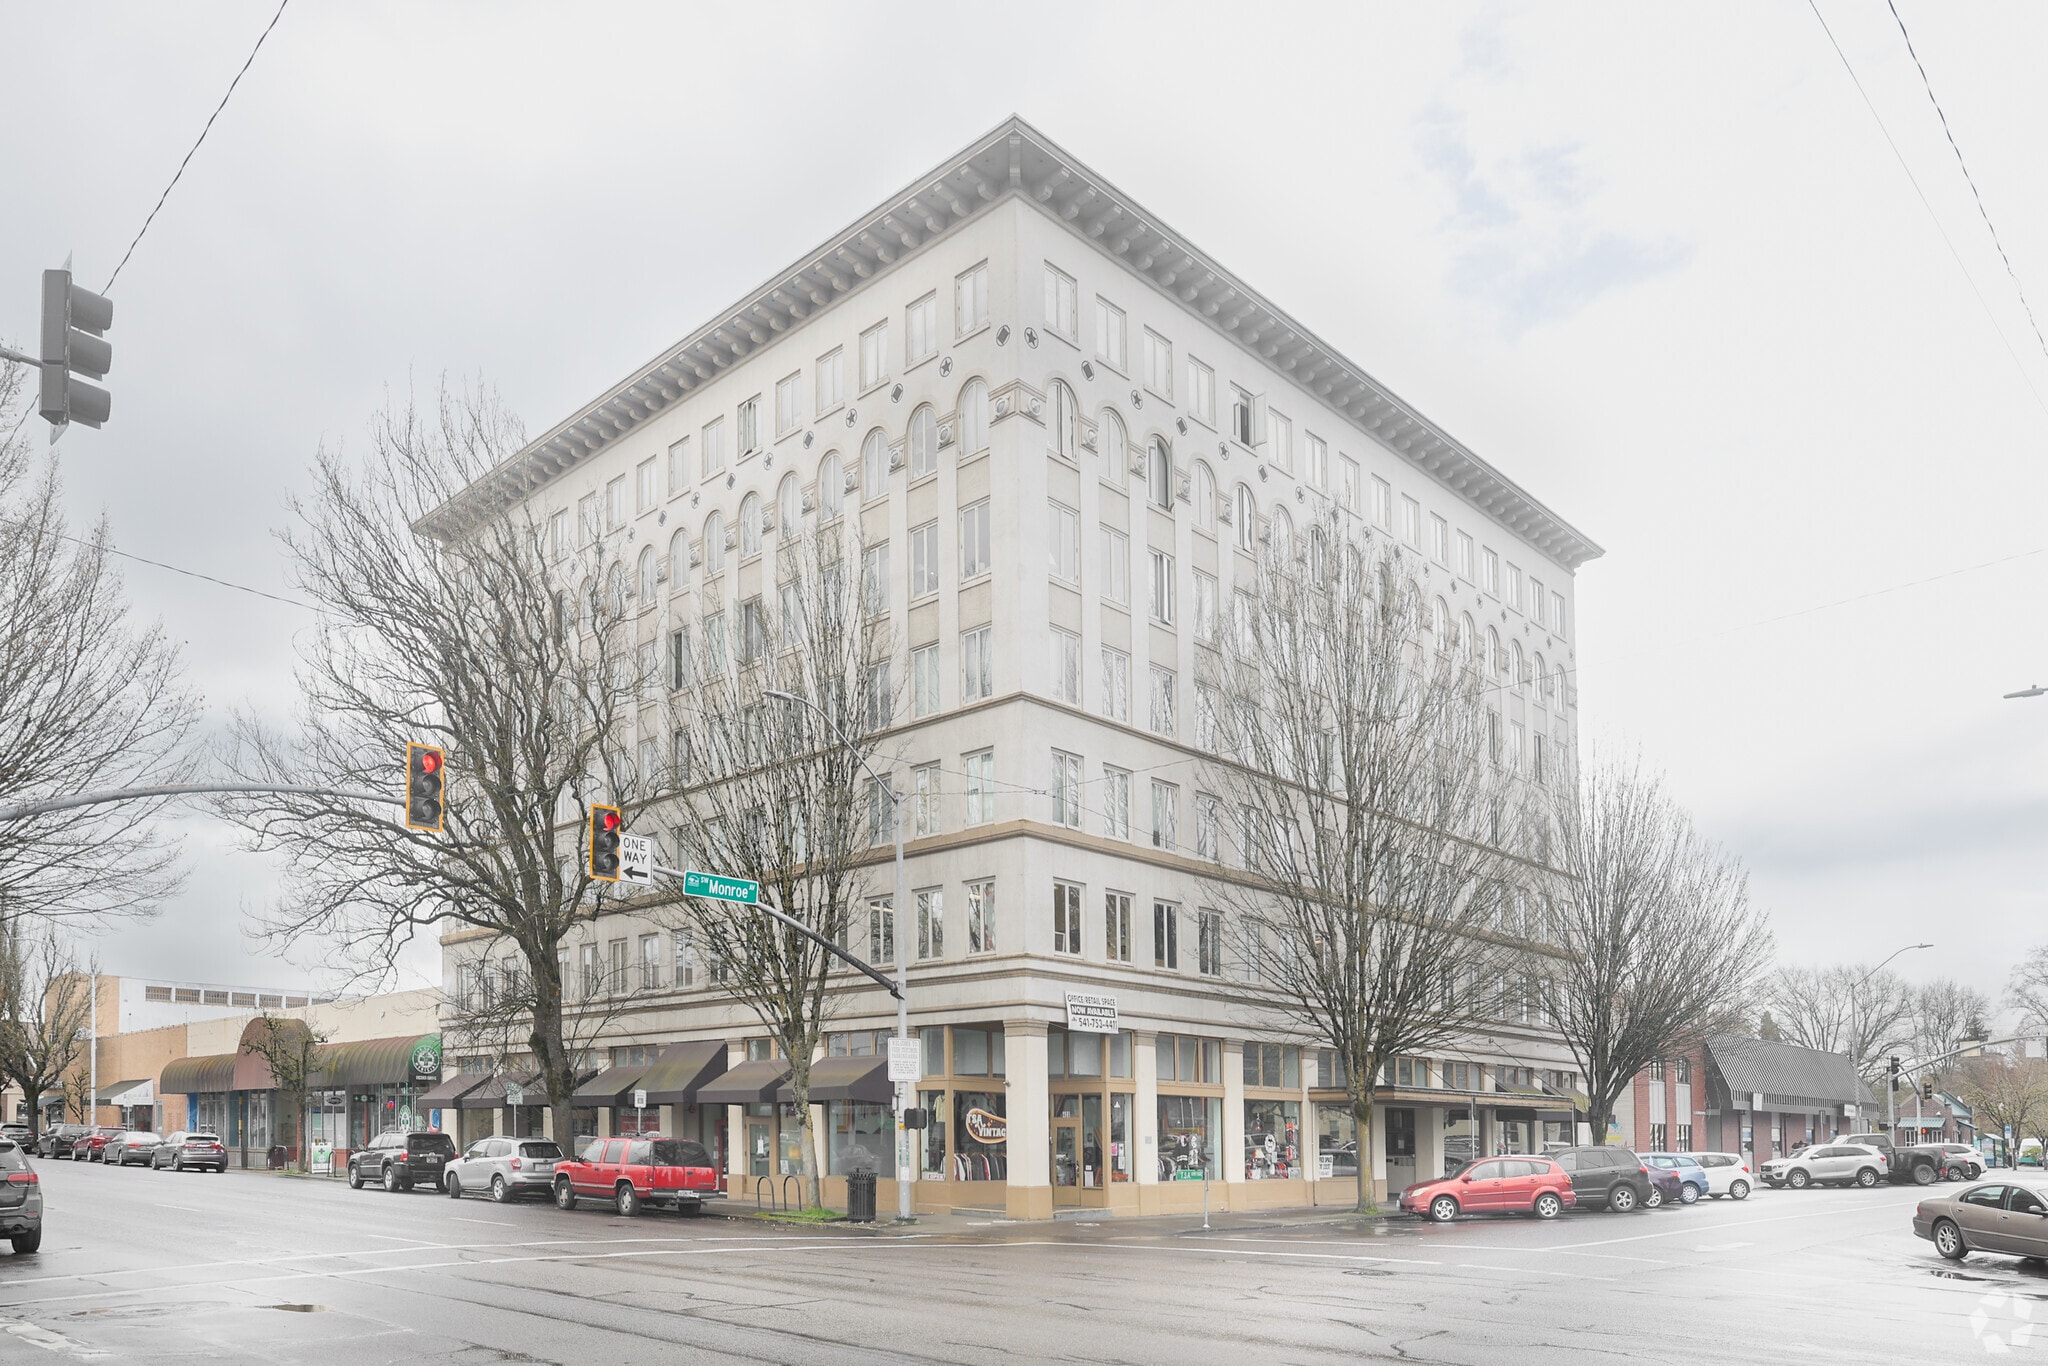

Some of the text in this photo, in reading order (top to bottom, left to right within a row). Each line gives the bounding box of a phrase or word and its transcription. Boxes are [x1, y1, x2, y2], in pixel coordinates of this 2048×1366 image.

[623, 837, 646, 851] ONE
[624, 850, 647, 865] WAY
[709, 880, 749, 899] Monroe
[1101, 997, 1116, 1006] SPACE
[1071, 1005, 1115, 1017] NOW AVAILABLE
